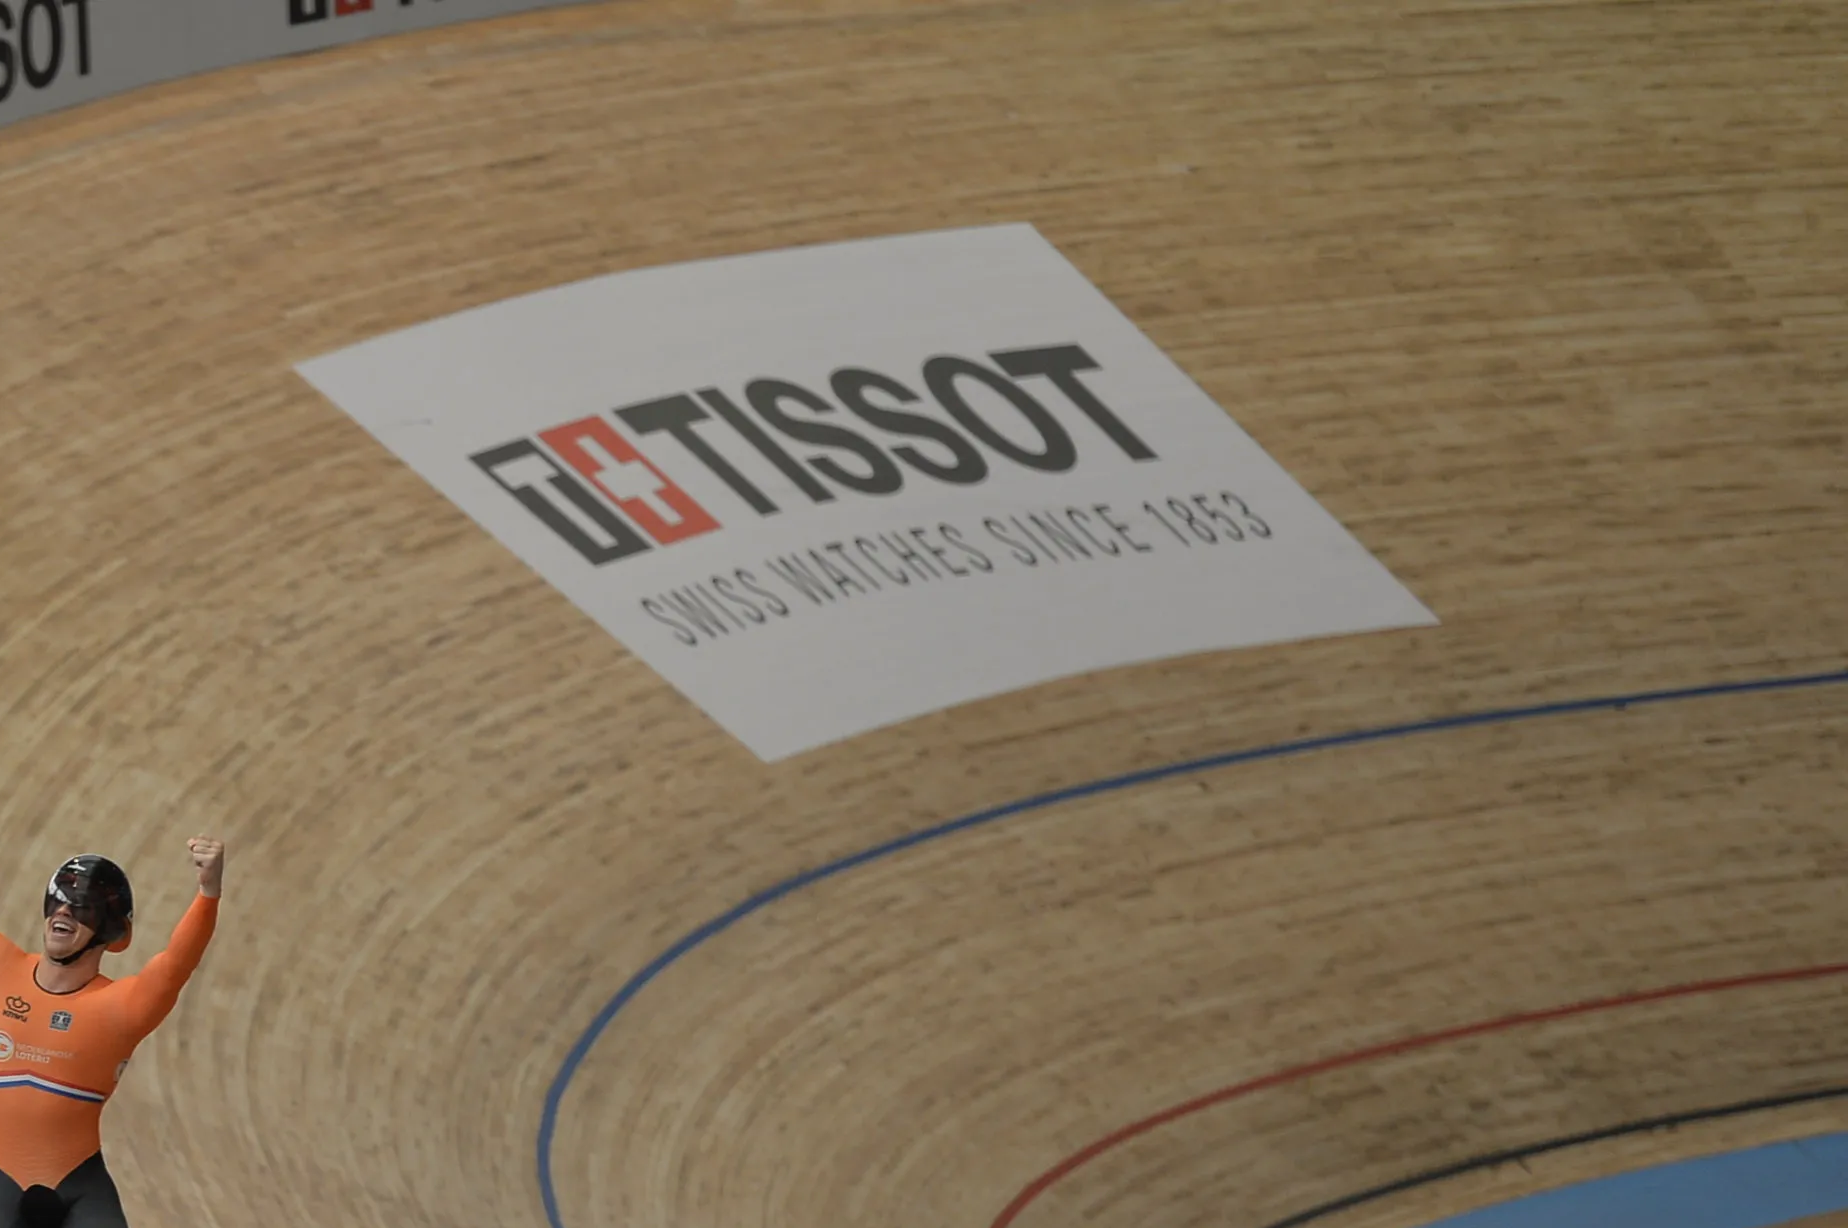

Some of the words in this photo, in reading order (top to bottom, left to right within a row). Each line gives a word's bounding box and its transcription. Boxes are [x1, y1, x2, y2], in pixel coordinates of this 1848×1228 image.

[613, 341, 1160, 518] TISSOT
[640, 567, 790, 648] SWISS
[764, 522, 994, 607] WATCHES
[982, 502, 1153, 568] SINCE
[1142, 489, 1273, 548] 1853
